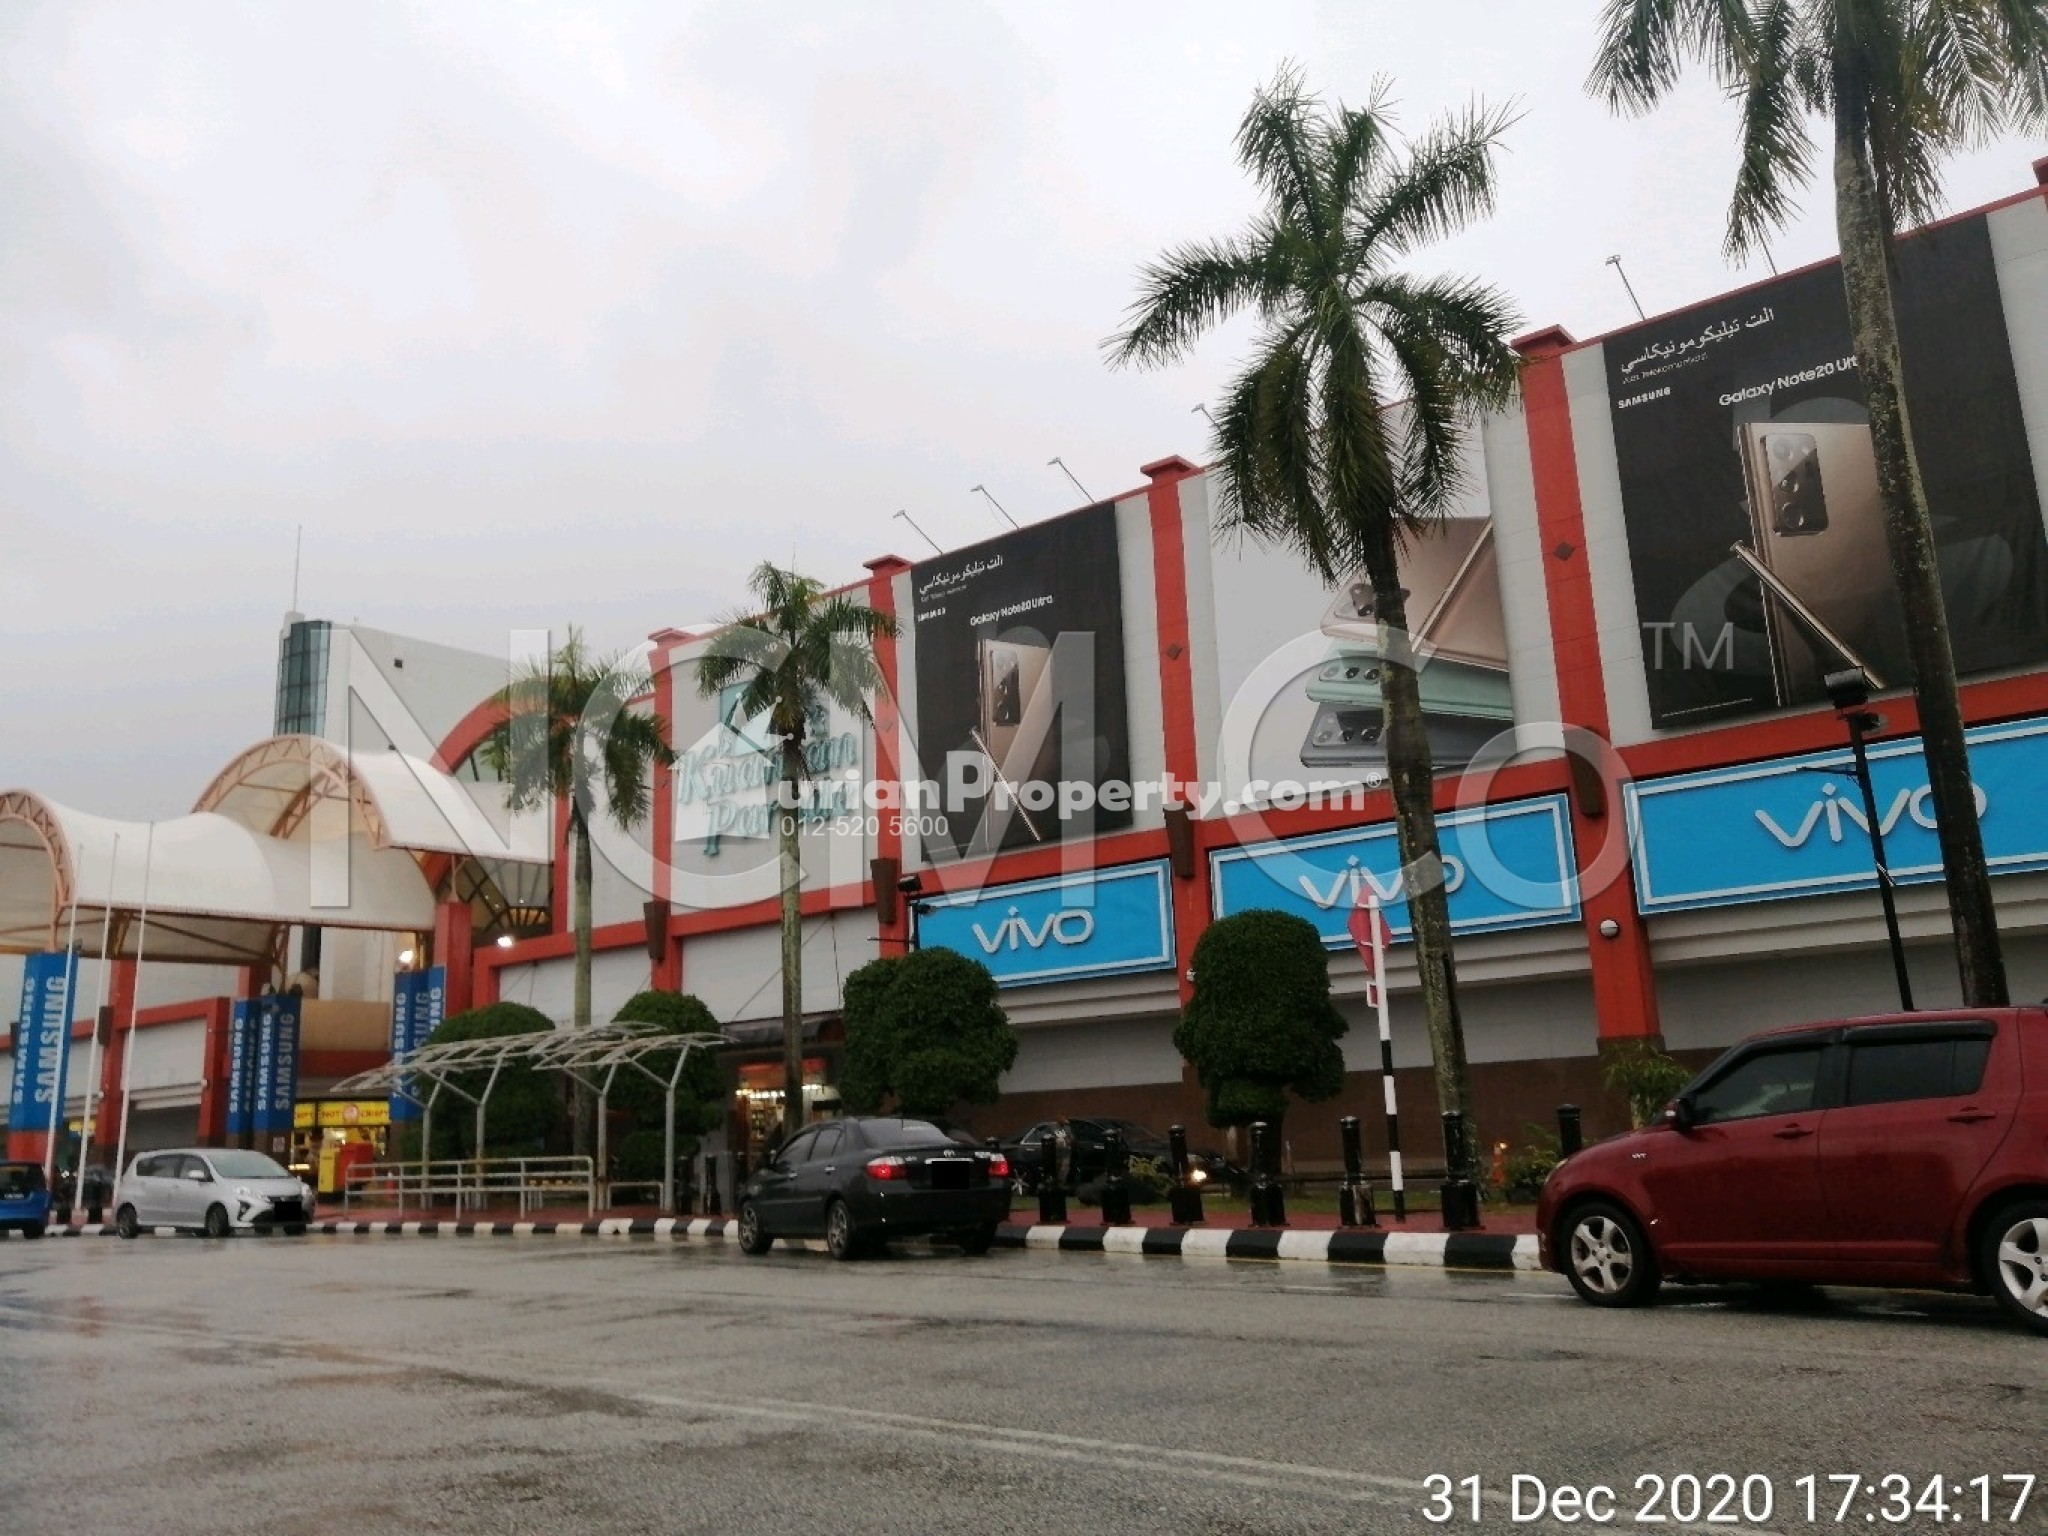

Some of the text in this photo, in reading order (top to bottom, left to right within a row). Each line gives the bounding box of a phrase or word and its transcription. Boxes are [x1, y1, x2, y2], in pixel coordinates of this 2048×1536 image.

[1617, 386, 1671, 409] SAMSUNG
[1718, 354, 1858, 406] Galaxy Note20 Ult
[677, 732, 858, 807] Kuanan
[972, 906, 1096, 954] vivo
[34, 975, 67, 1103] SAMSUNG
[257, 1013, 272, 1111] SAMSUNG
[275, 1013, 295, 1111] SAMSUNG
